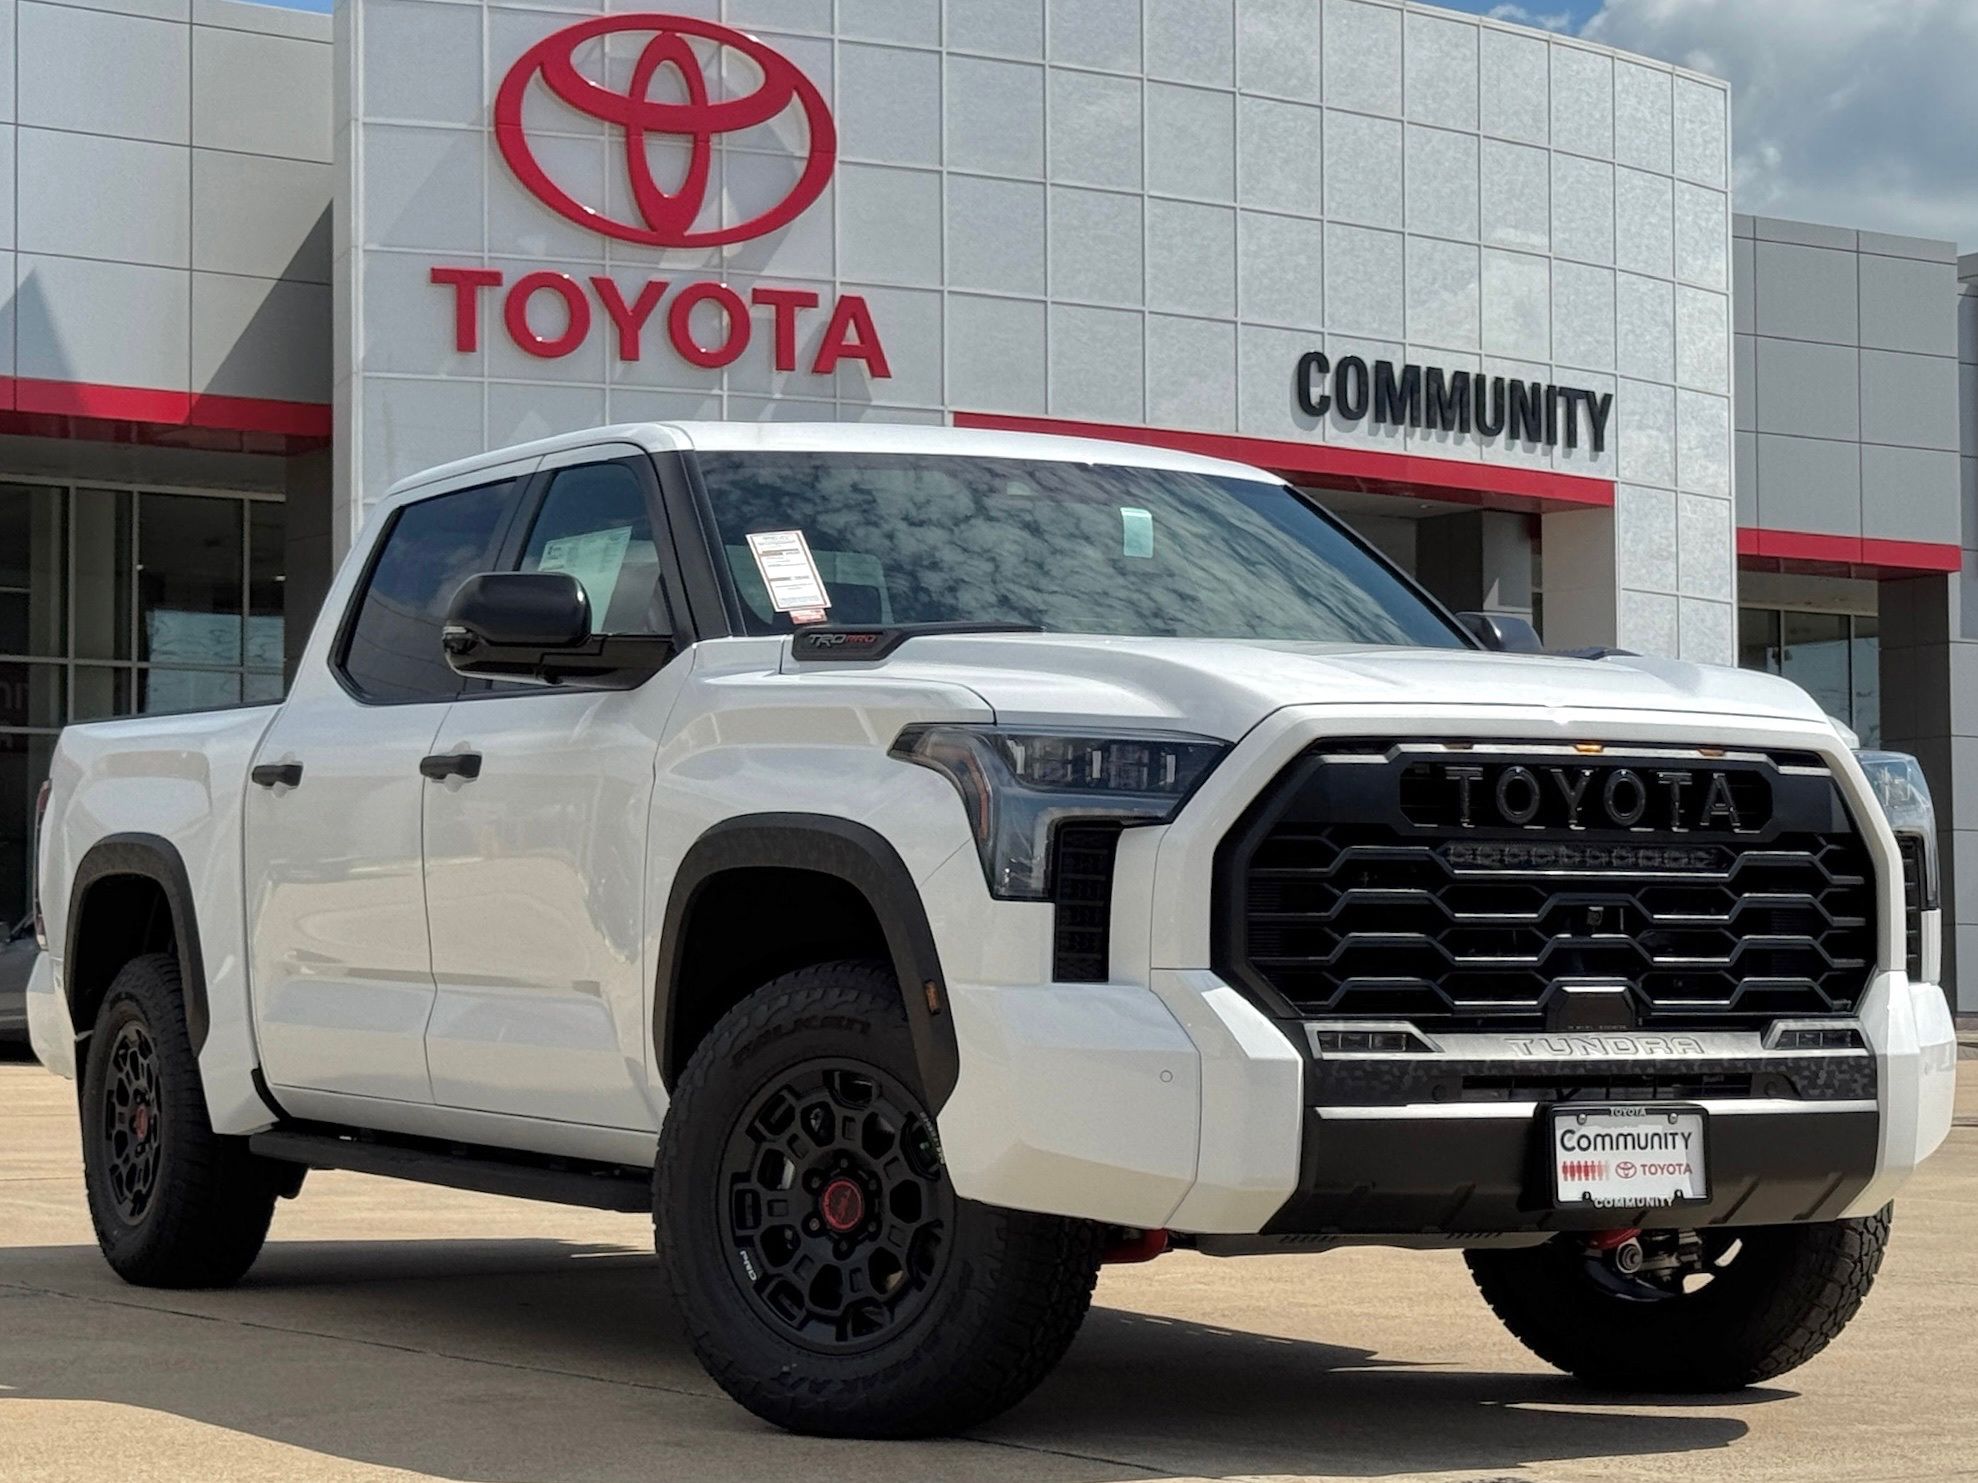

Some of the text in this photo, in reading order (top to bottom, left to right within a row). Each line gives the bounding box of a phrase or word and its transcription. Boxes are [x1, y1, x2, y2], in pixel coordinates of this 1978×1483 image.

[430, 267, 892, 379] TOYOTA
[1297, 351, 1614, 453] COMMUNITY
[809, 634, 847, 648] TRD
[1445, 765, 1741, 830] TOYOTA
[1504, 1036, 1705, 1056] TUNDRA
[1610, 1106, 1647, 1117] TOYOTA
[1640, 1163, 1693, 1176] TOYOTA
[1594, 1196, 1674, 1209] COMMUNITY
